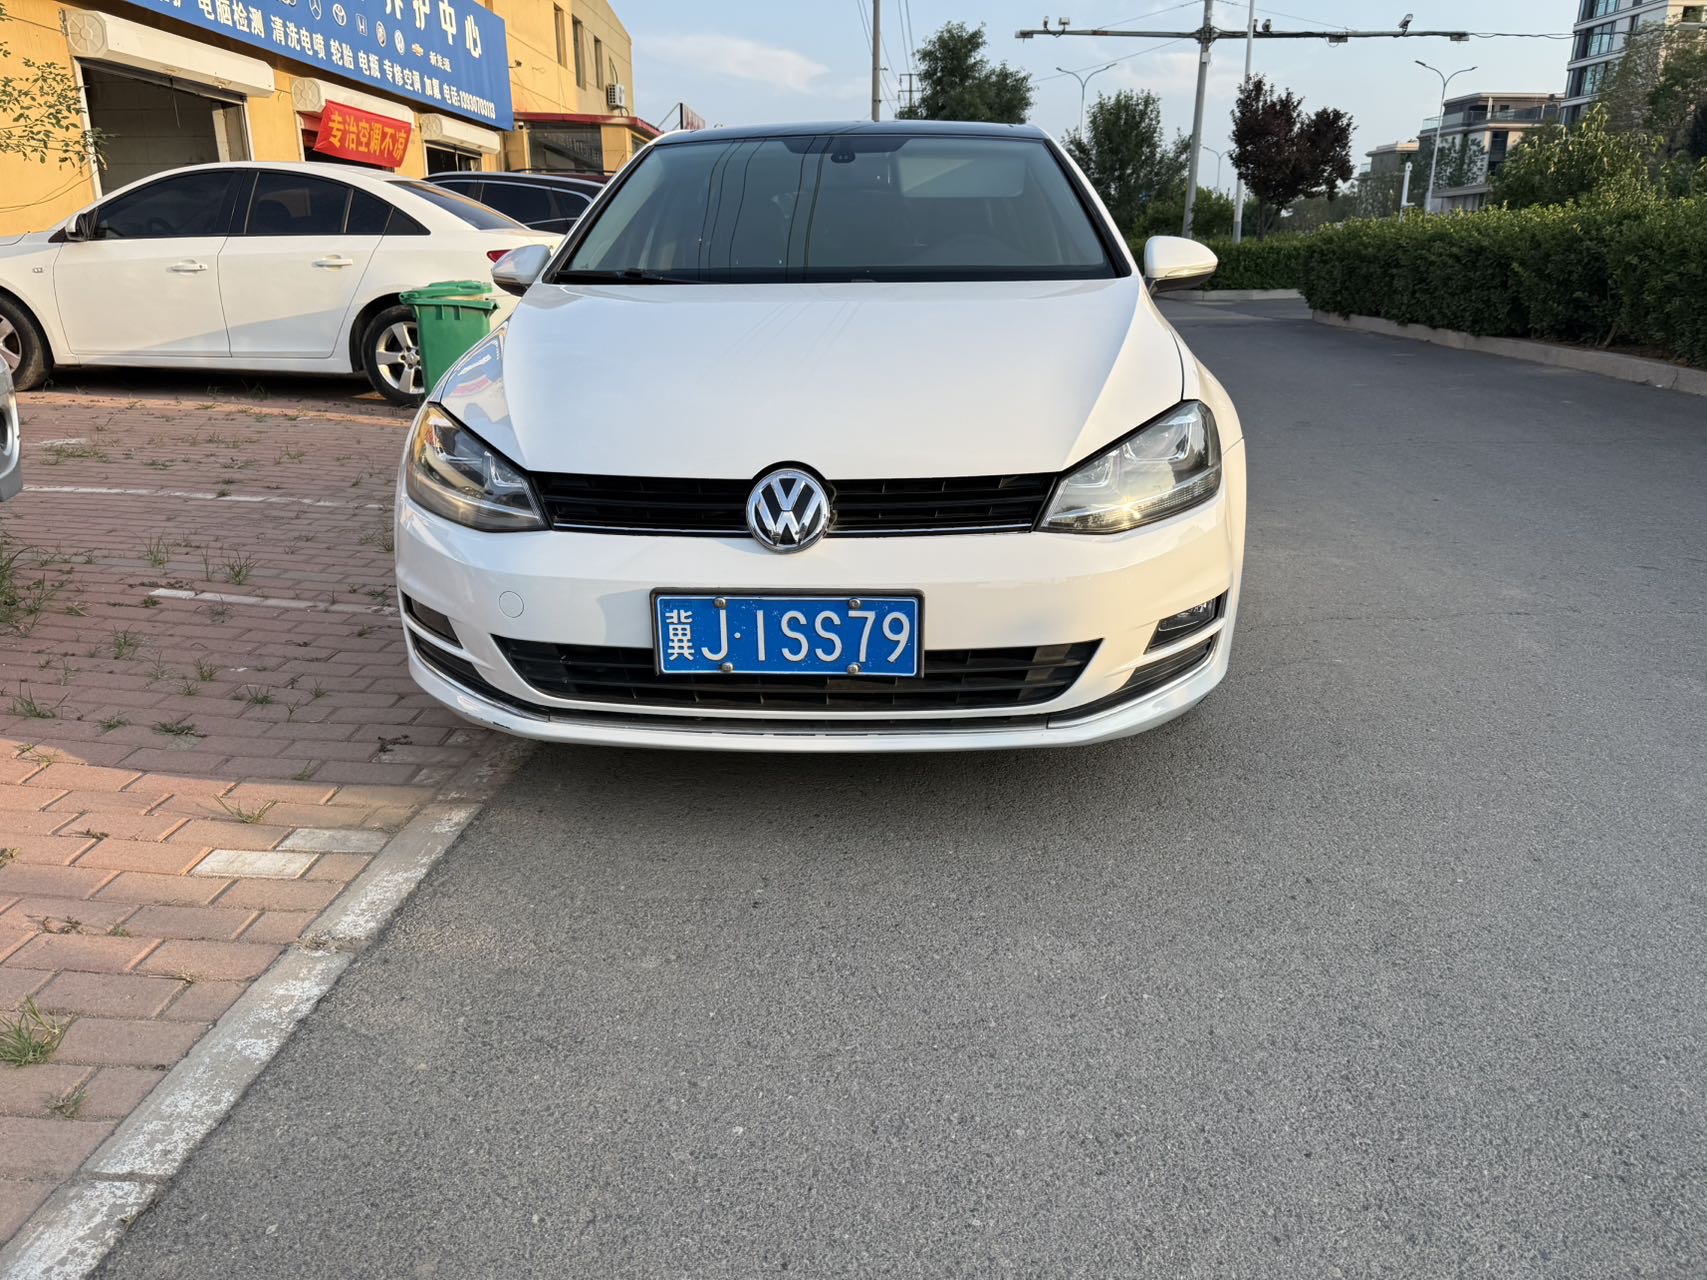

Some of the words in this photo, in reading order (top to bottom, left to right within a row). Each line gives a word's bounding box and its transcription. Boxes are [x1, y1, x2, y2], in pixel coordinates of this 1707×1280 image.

[270, 14, 326, 60] 清洗电喷
[330, 38, 354, 70] 轮胎
[358, 50, 380, 79] 电瓶
[383, 59, 422, 93] 专修空调
[328, 111, 407, 160] 专治空调不凉
